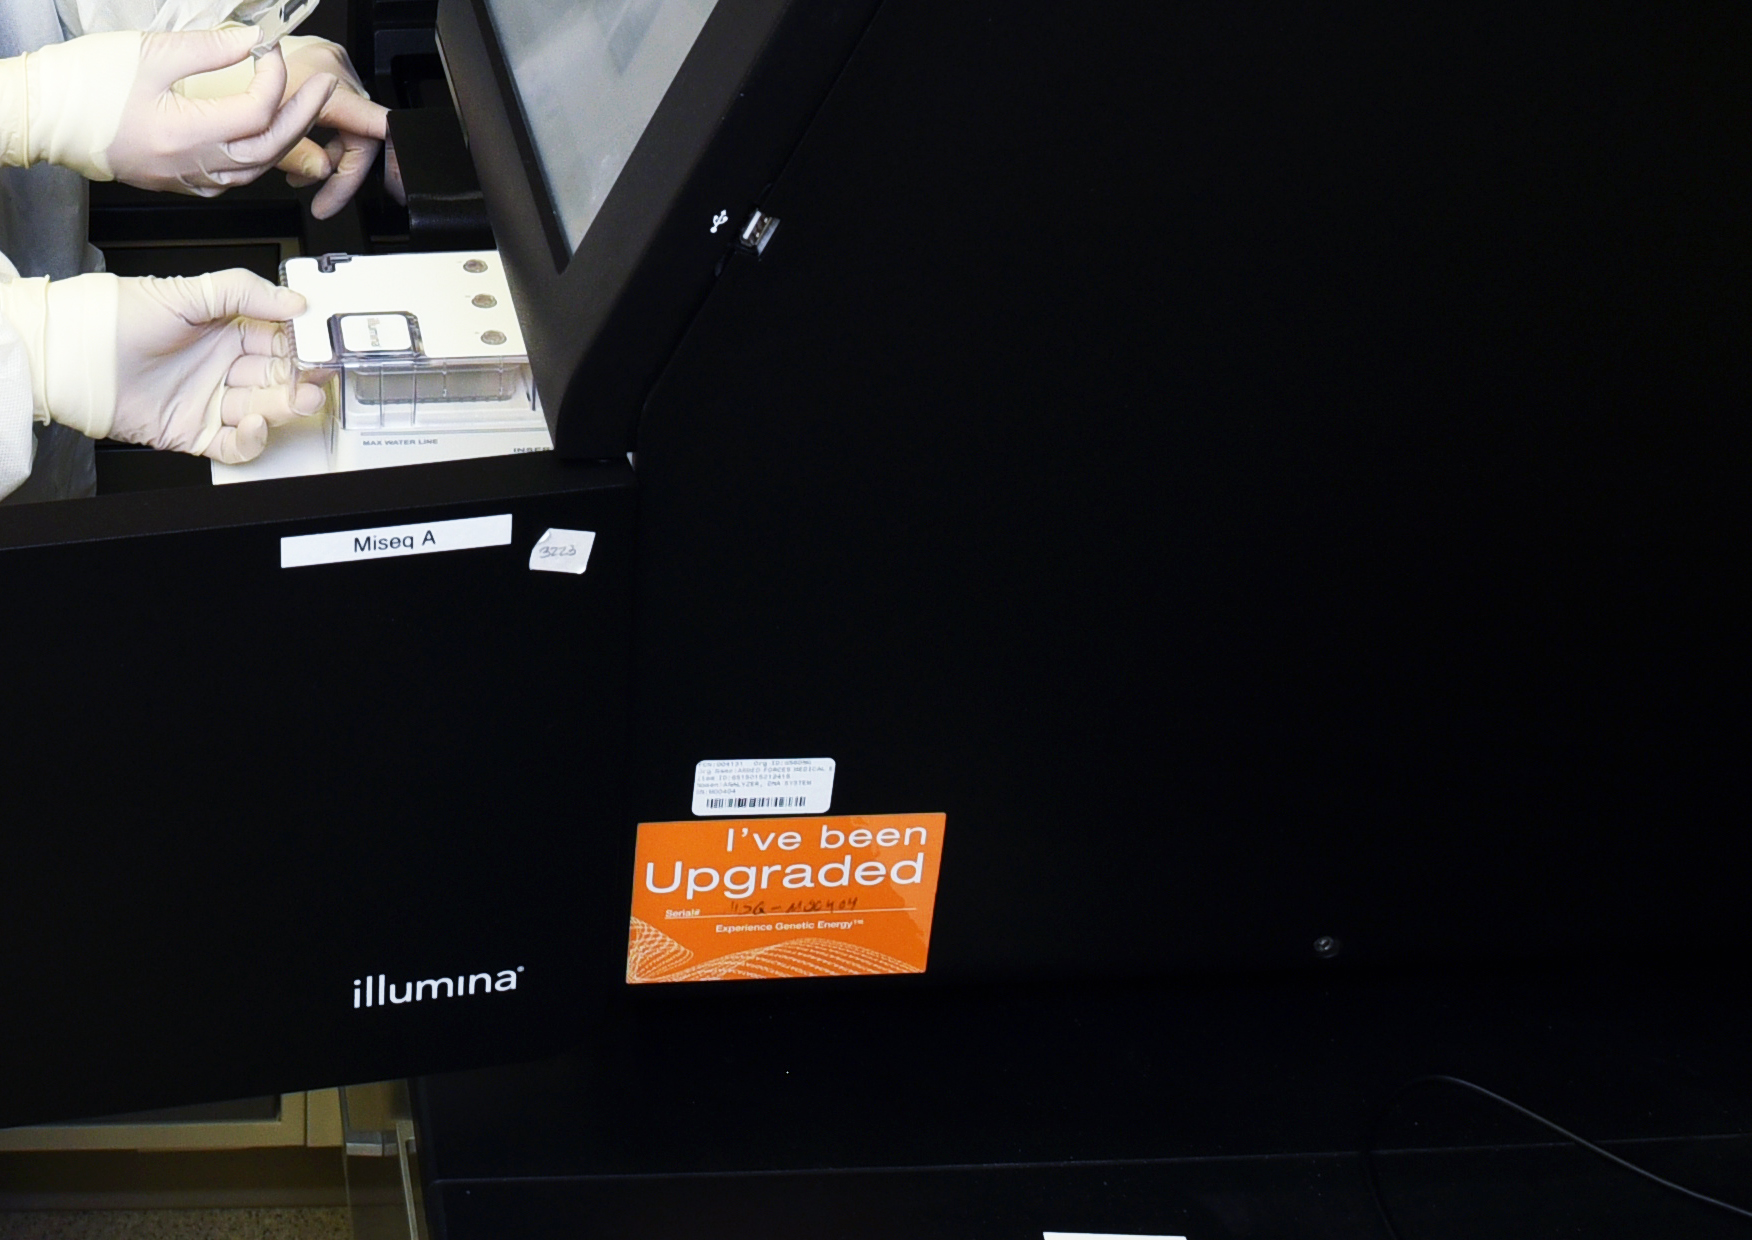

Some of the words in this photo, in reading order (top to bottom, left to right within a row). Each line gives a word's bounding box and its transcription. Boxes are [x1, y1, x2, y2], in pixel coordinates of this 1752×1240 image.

[354, 535, 414, 553] Miseq
[422, 530, 436, 546] A
[820, 825, 927, 849] been
[645, 852, 924, 900] Upgraded
[715, 923, 773, 933] Experience
[775, 921, 815, 931] Genetic
[353, 968, 518, 1009] illumina
